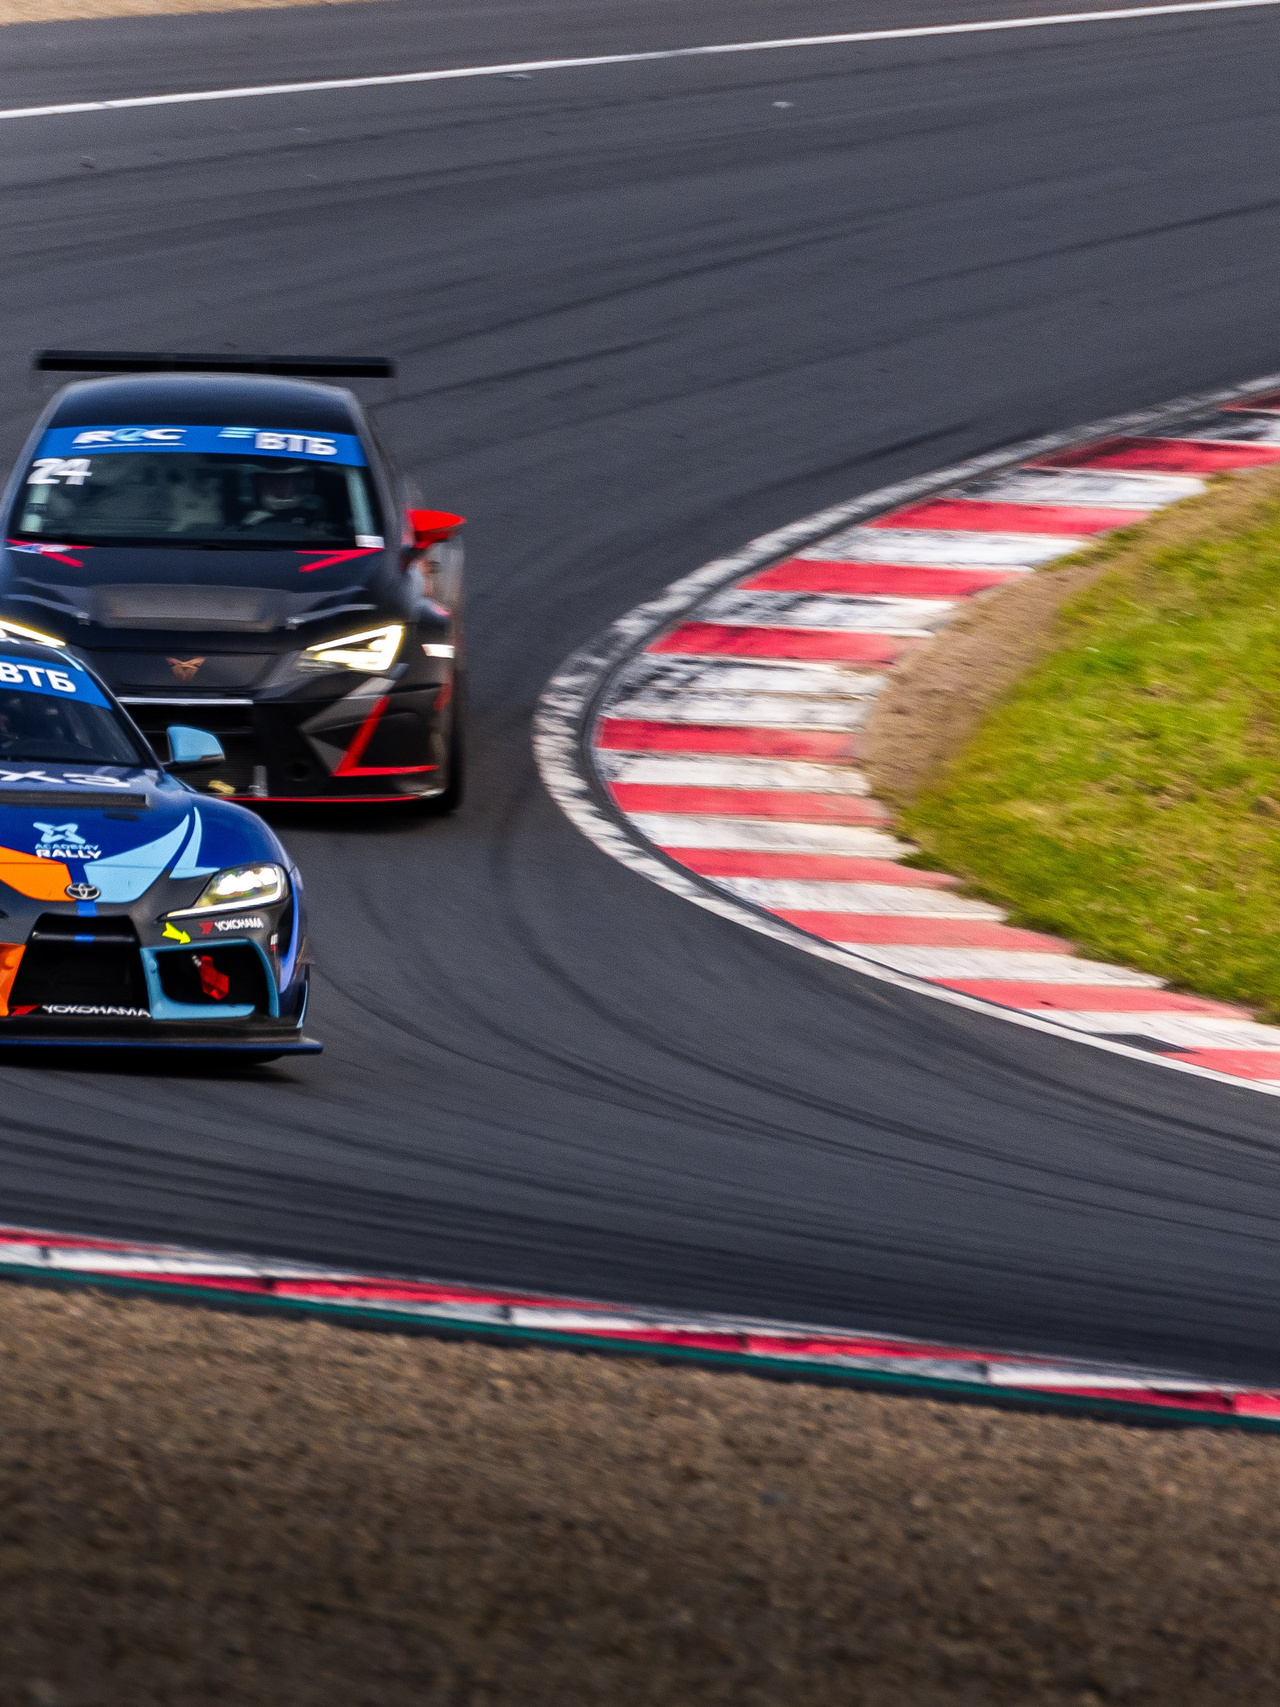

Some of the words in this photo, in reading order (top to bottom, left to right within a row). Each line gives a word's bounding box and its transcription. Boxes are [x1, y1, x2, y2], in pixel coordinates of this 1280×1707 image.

[26, 457, 93, 486] 24
[35, 849, 102, 859] RALLY
[214, 916, 264, 931] YOKOHAMA
[42, 1004, 152, 1019] YOKOHAMA
